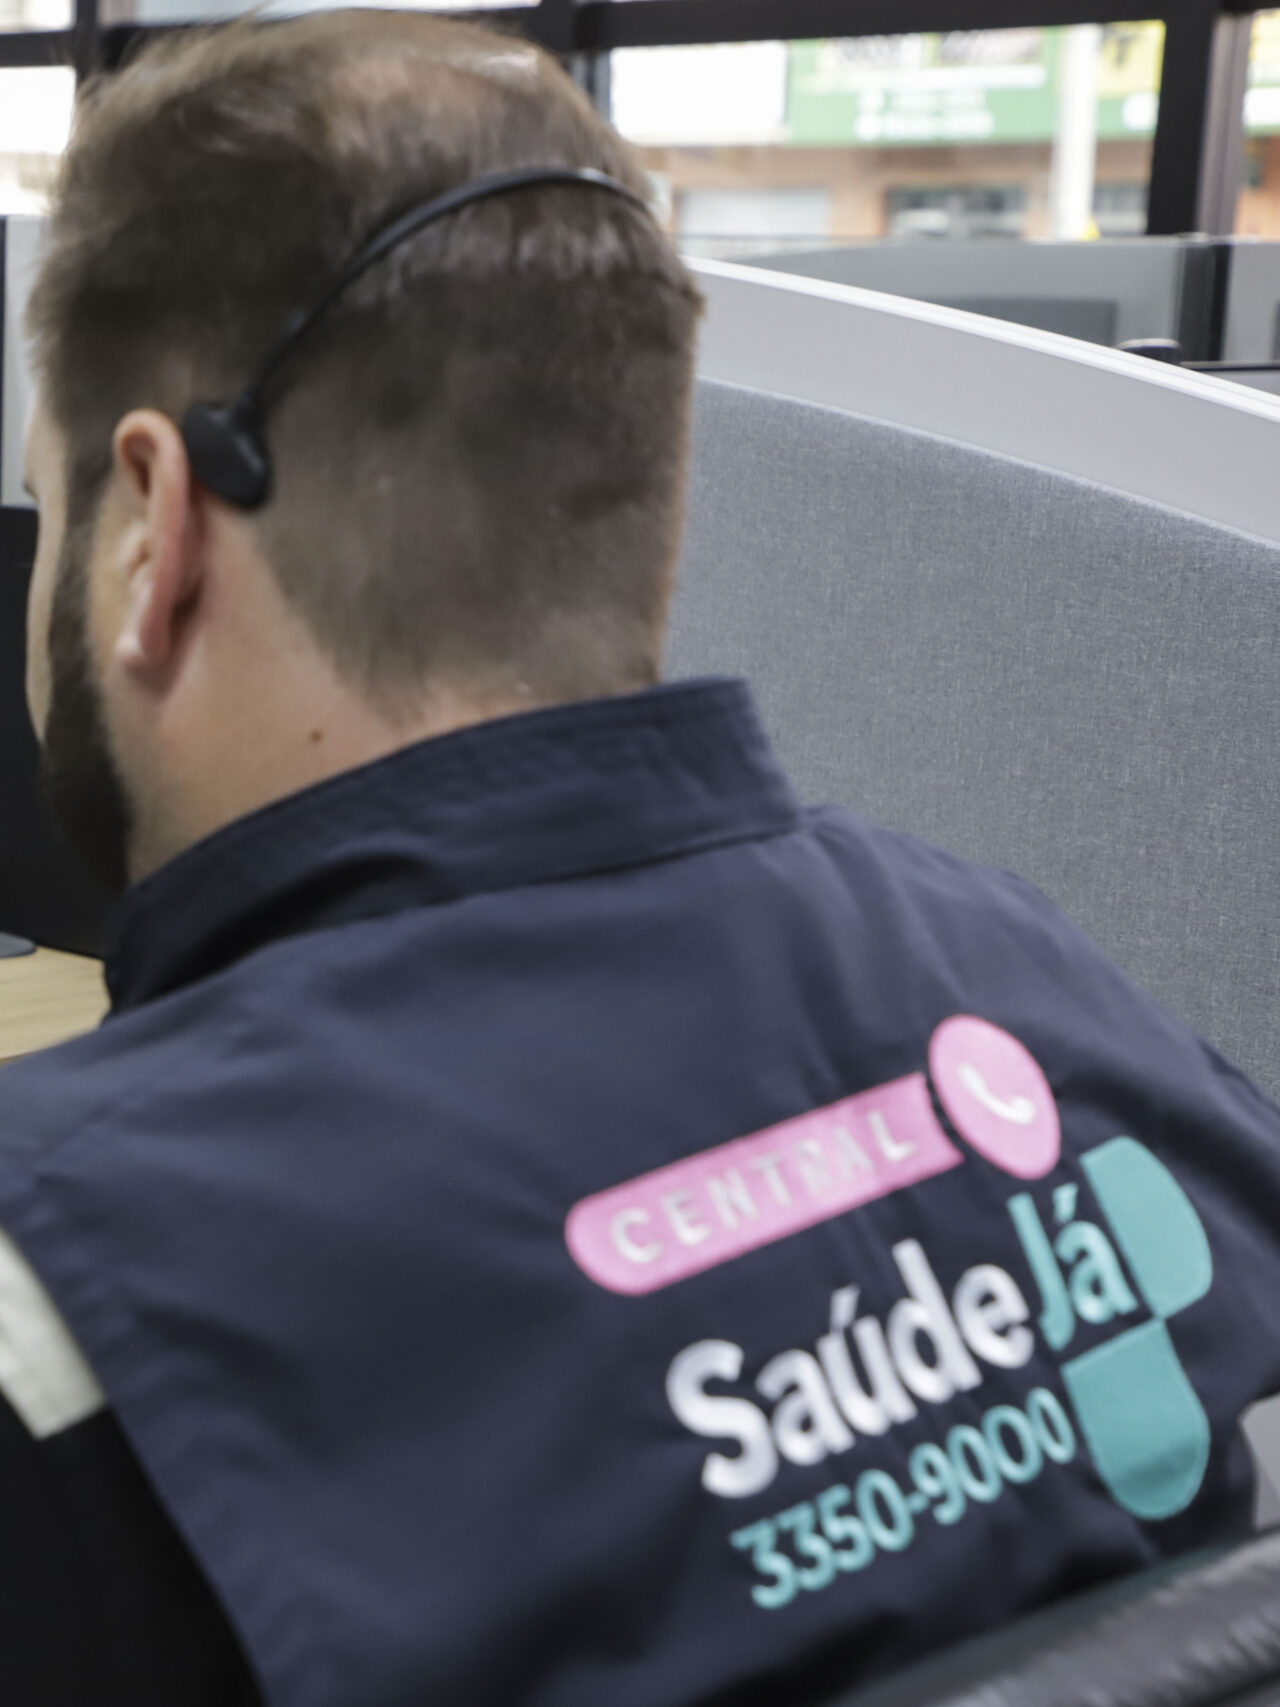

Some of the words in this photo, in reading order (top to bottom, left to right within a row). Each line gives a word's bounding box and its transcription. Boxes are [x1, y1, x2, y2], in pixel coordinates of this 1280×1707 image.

[610, 1108, 917, 1264] CENTRAL
[666, 1238, 1035, 1498] Saúde
[1007, 1183, 1140, 1350] Já
[730, 1387, 1077, 1608] 3350-9000
